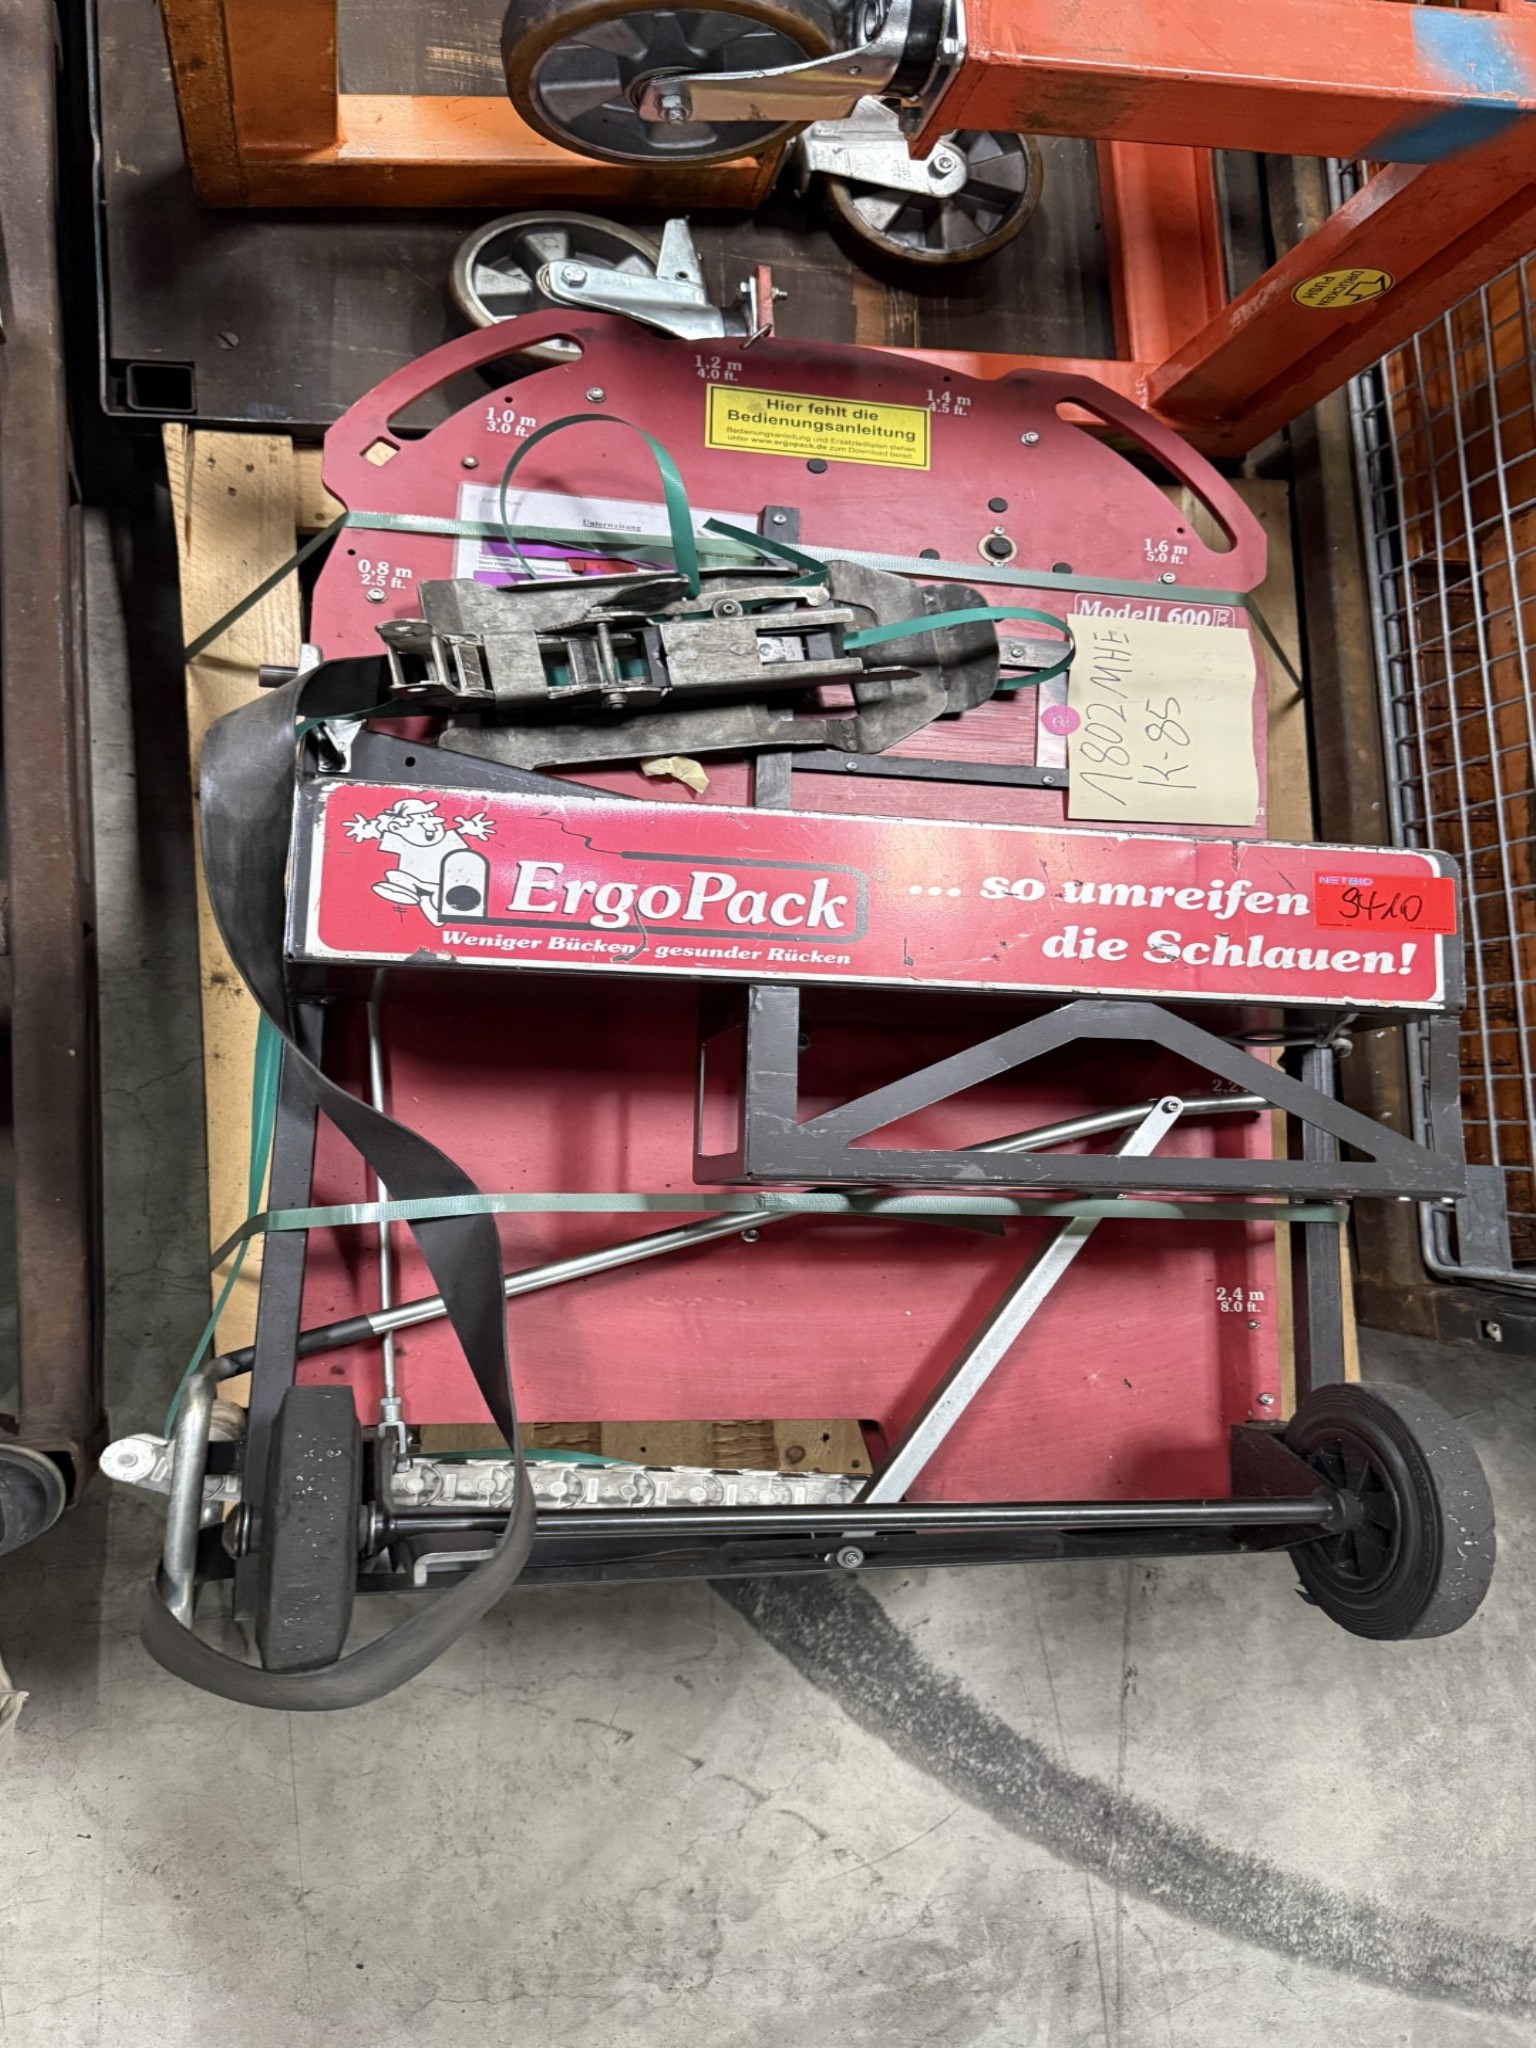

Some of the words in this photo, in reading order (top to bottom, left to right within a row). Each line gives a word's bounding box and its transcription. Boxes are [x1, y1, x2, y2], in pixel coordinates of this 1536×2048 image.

[1302, 276, 1337, 299] PUSH
[694, 355, 722, 369] 1,2
[727, 361, 742, 371] m
[696, 367, 720, 380] 4.0
[724, 371, 738, 382] ft.
[926, 389, 951, 404] 1,4
[956, 396, 971, 406] m
[486, 407, 515, 424] 1,0
[520, 416, 537, 428] m
[766, 399, 804, 413] Hier
[808, 403, 848, 418] fehlt
[853, 408, 879, 421] die
[928, 402, 950, 414] 4.5
[953, 406, 968, 416] ft.
[486, 420, 512, 434] 3.0
[515, 424, 530, 437] ft.
[727, 409, 916, 442] Bedienungsanleitung
[726, 426, 811, 442] Bedienungsanleitung
[813, 436, 828, 444] und
[830, 437, 888, 449] Ersatzteillisten
[890, 444, 916, 452] stehen
[751, 437, 827, 450] www.ergopack.de
[848, 446, 888, 456] Download
[1144, 538, 1170, 553] 1,6
[1173, 545, 1188, 555] m
[1147, 552, 1168, 563] 5.0
[1171, 554, 1184, 565] ft.
[357, 559, 390, 577] 0,8
[395, 567, 413, 578] m
[361, 574, 386, 586] 2.5
[390, 578, 407, 590] ft.
[1079, 600, 1161, 622] Modell
[1167, 606, 1210, 627] 600
[1318, 876, 1374, 886] NETBID
[506, 861, 848, 930] ErgoPack
[979, 876, 1046, 901] so
[1061, 880, 1310, 919] umreifen
[441, 931, 543, 950] Weniger
[547, 936, 638, 954] Bücken
[654, 945, 763, 960] gesunder
[767, 947, 852, 965] Rücken
[1042, 926, 1128, 960] die
[1142, 930, 1418, 974] Schlauen!
[1216, 1287, 1243, 1302] 2,4
[1249, 1290, 1265, 1301] m
[1220, 1301, 1242, 1312] 8.0
[1246, 1301, 1261, 1312] ft.
